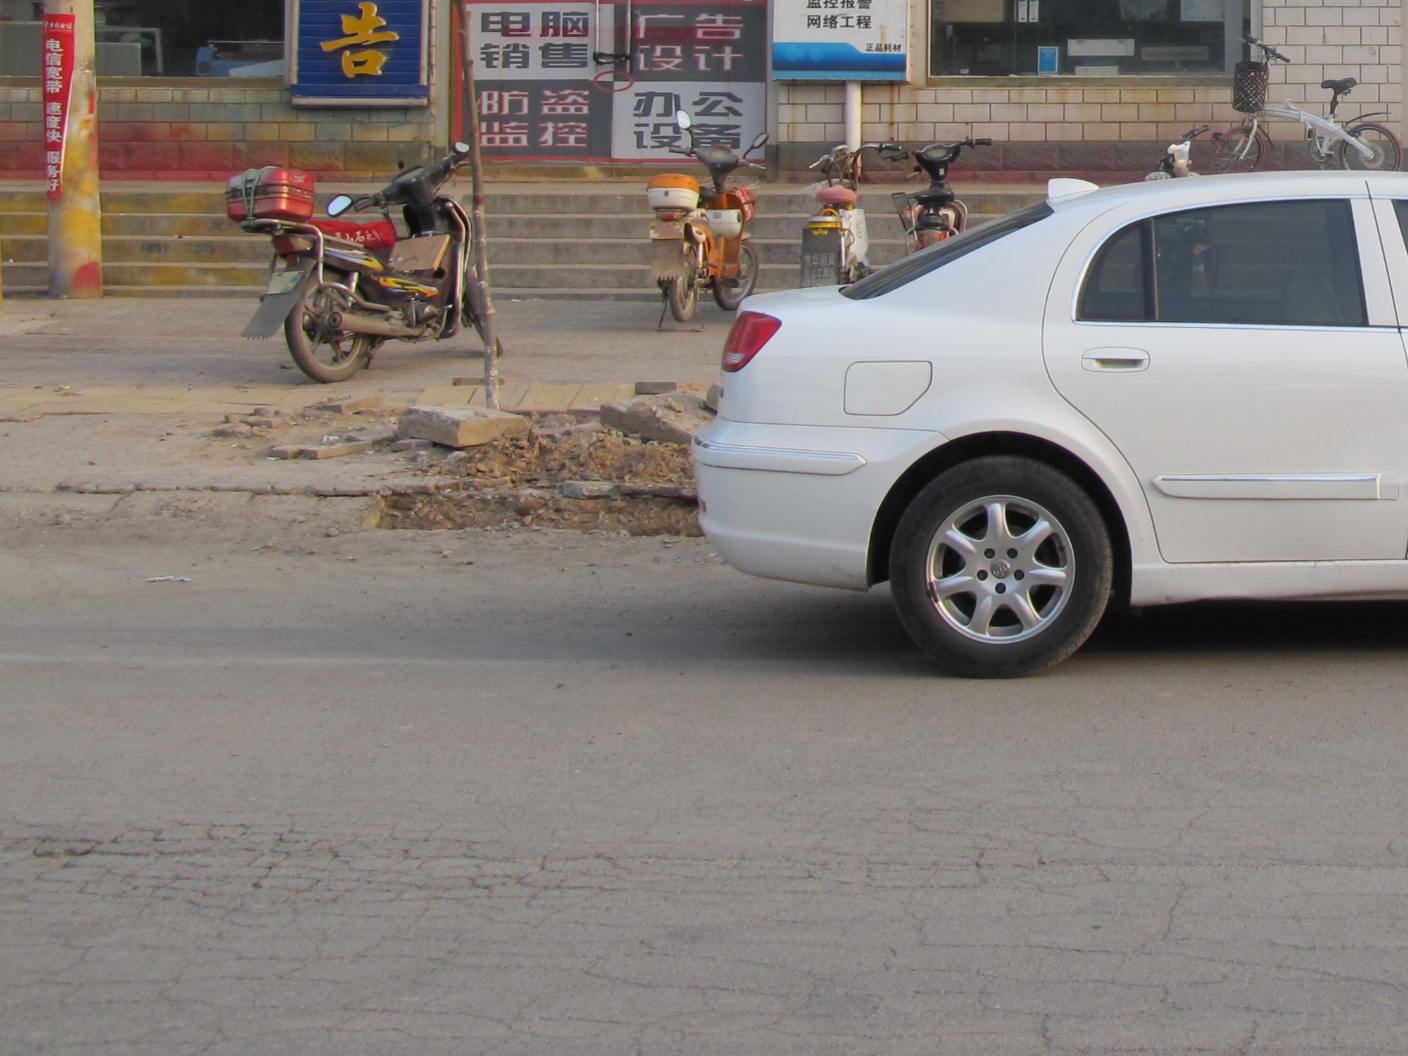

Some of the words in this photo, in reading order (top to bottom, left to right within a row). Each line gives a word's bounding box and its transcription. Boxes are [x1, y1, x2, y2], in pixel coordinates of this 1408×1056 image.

[480, 11, 589, 38] 电脑
[637, 13, 744, 39] 广告
[806, 15, 872, 29] 网络工程
[479, 43, 588, 69] 销售
[637, 45, 743, 71] 设计
[865, 43, 902, 53] 正品耗材
[478, 90, 590, 115] 防盗
[632, 92, 743, 117] 办公
[478, 122, 587, 148] 监控
